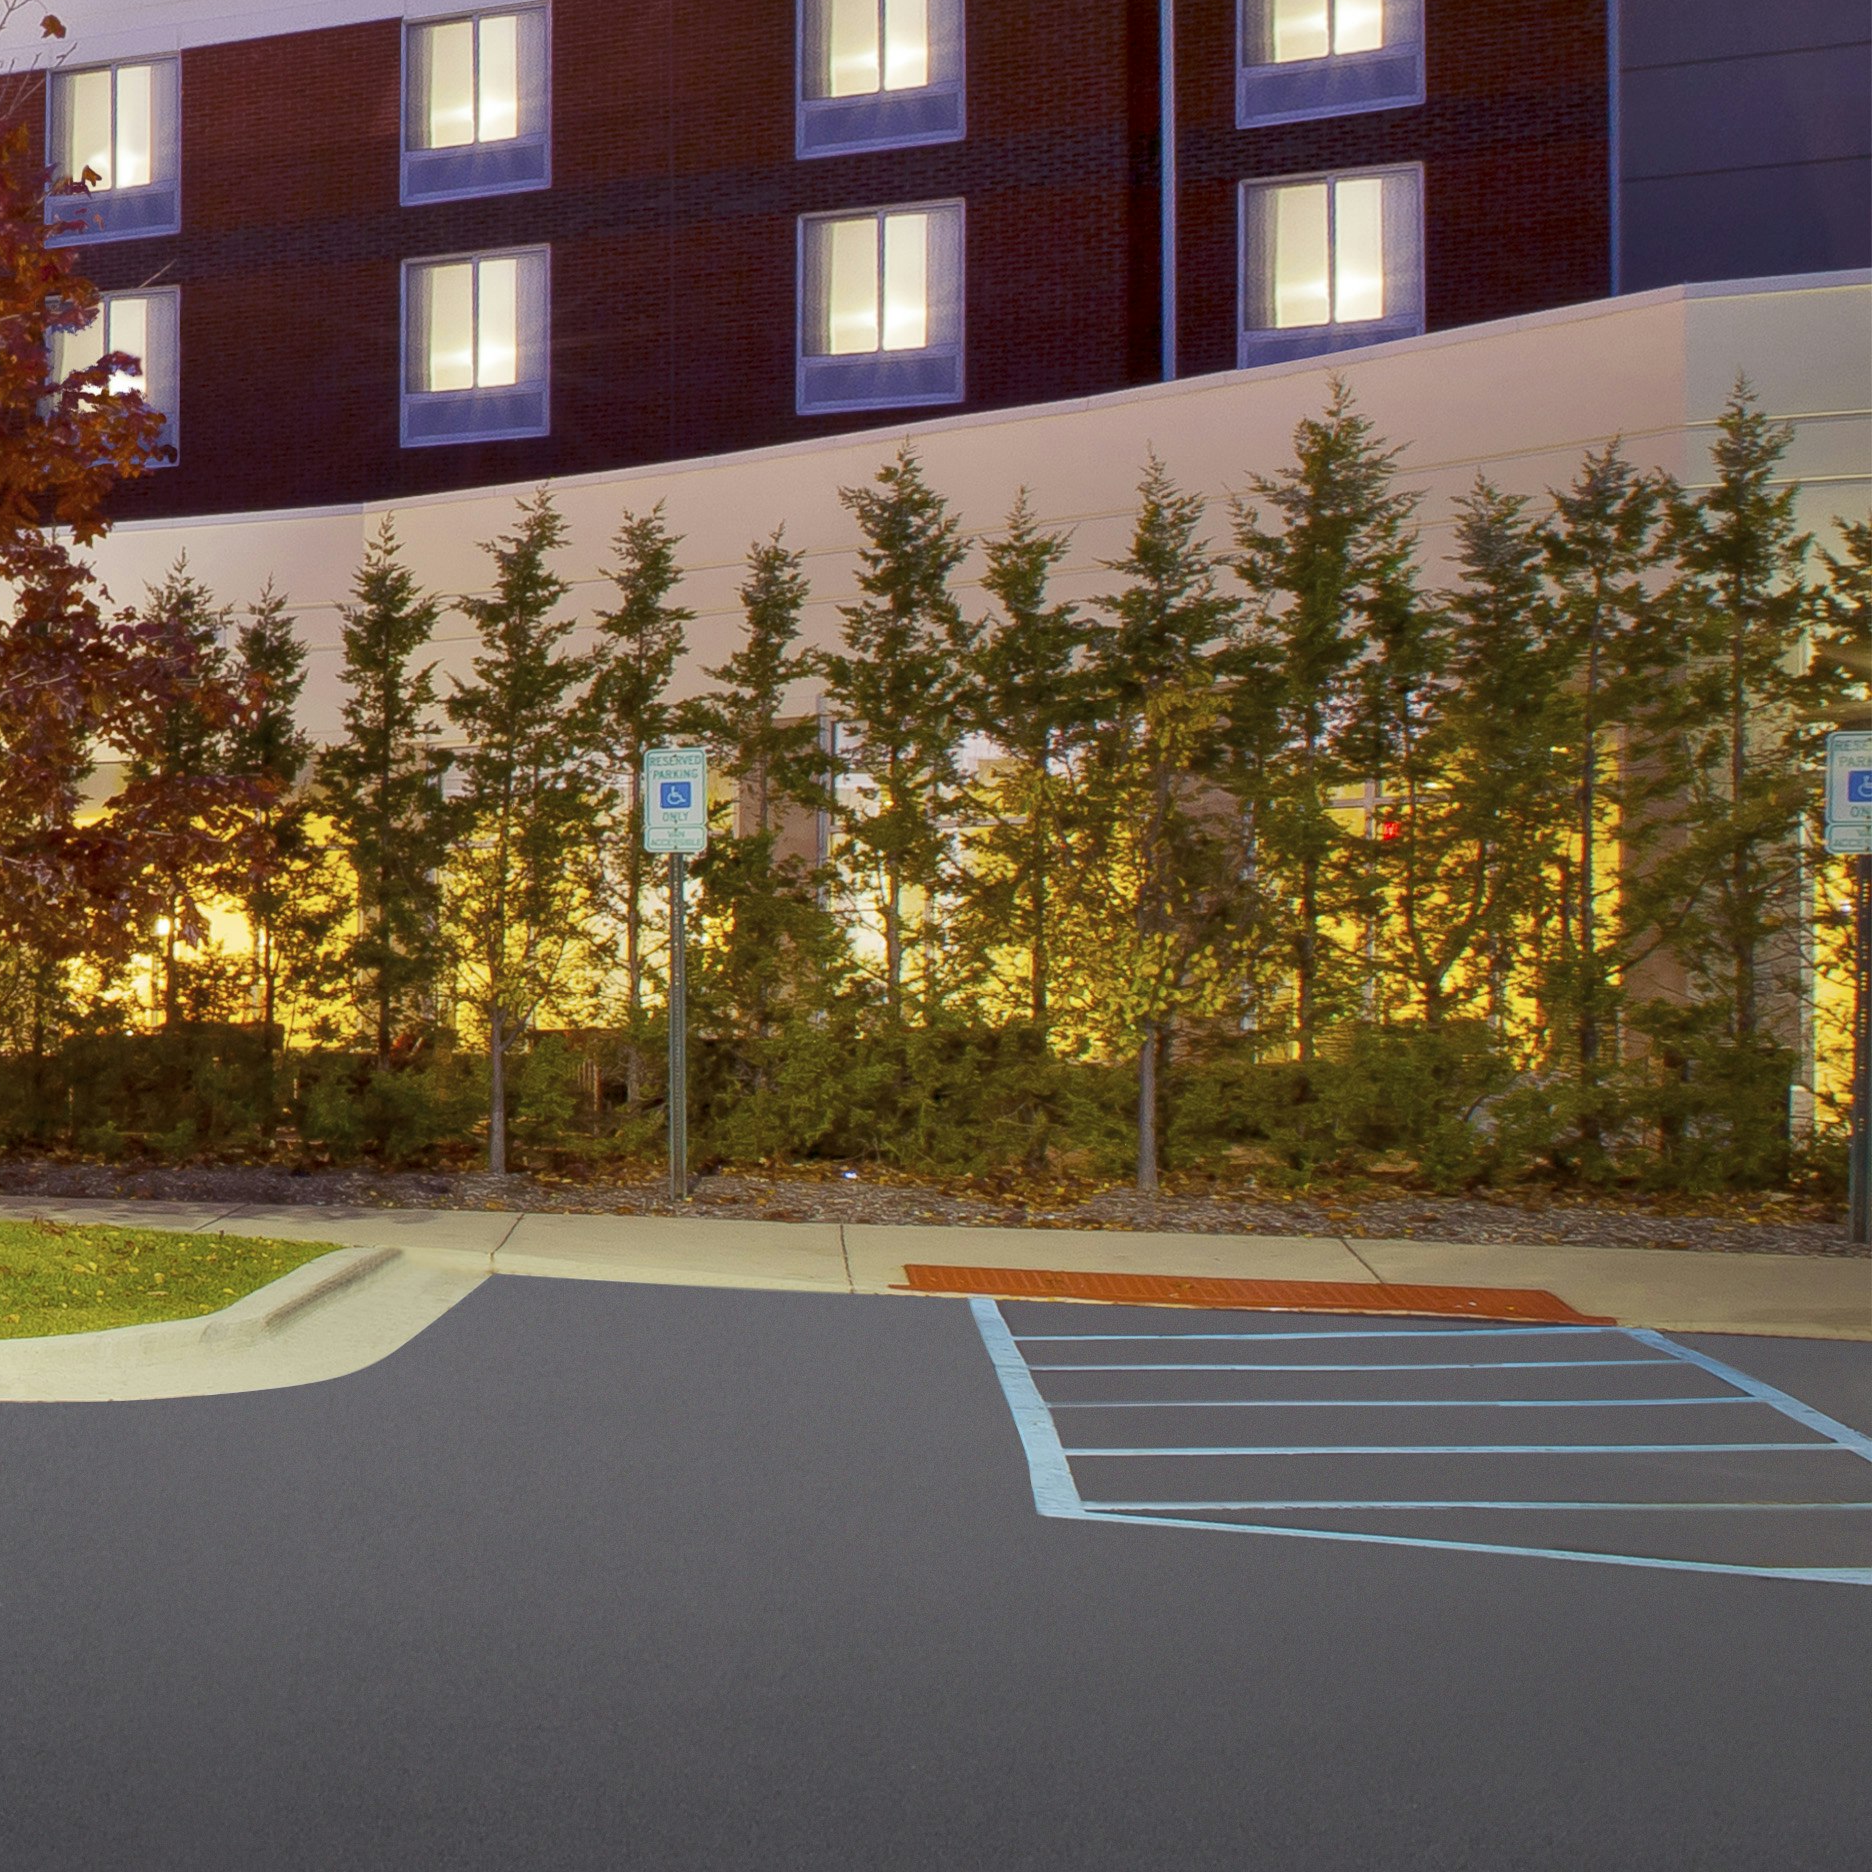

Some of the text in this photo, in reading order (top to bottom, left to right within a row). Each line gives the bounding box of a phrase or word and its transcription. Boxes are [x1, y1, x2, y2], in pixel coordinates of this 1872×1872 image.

[648, 755, 702, 767] RESERVED
[653, 768, 699, 779] PARKING
[662, 811, 689, 823] ONLY
[650, 838, 704, 847] ACCESSIBLE
